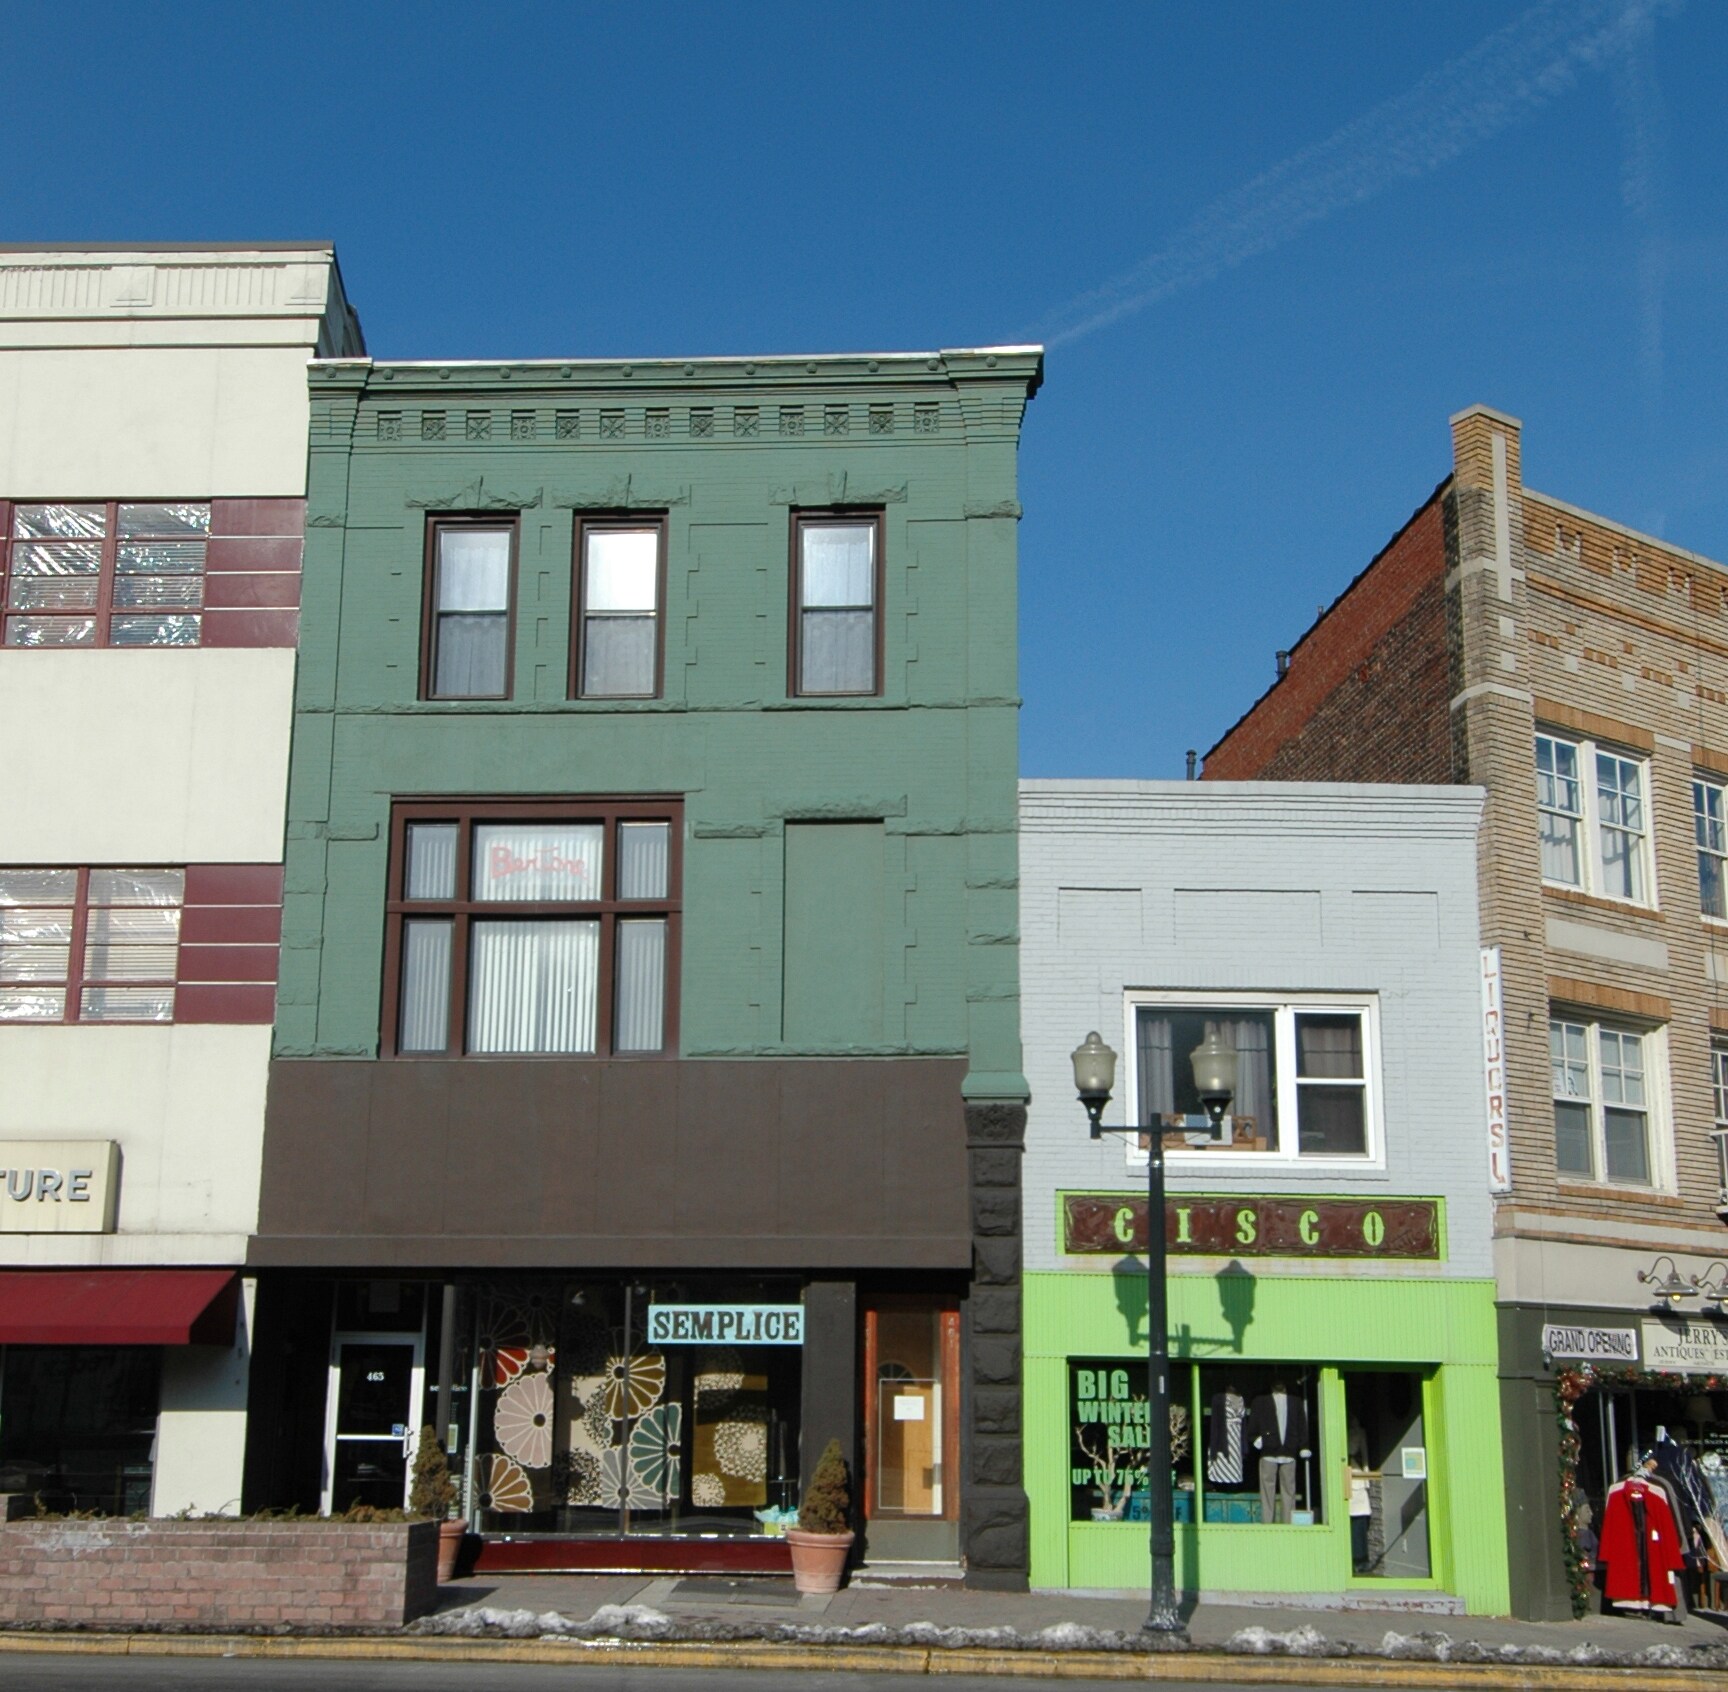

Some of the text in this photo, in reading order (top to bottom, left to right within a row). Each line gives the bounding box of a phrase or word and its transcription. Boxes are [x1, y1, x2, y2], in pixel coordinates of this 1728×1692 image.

[1112, 1206, 1386, 1247] CISCO
[653, 1310, 800, 1341] SEMPLICE
[1550, 1330, 1631, 1355] GRAND OPENING
[1654, 1345, 1704, 1360] ANTIQUES
[1077, 1369, 1129, 1400] BIG
[1077, 1401, 1150, 1424] WINTE
[1072, 1468, 1091, 1485] UP
